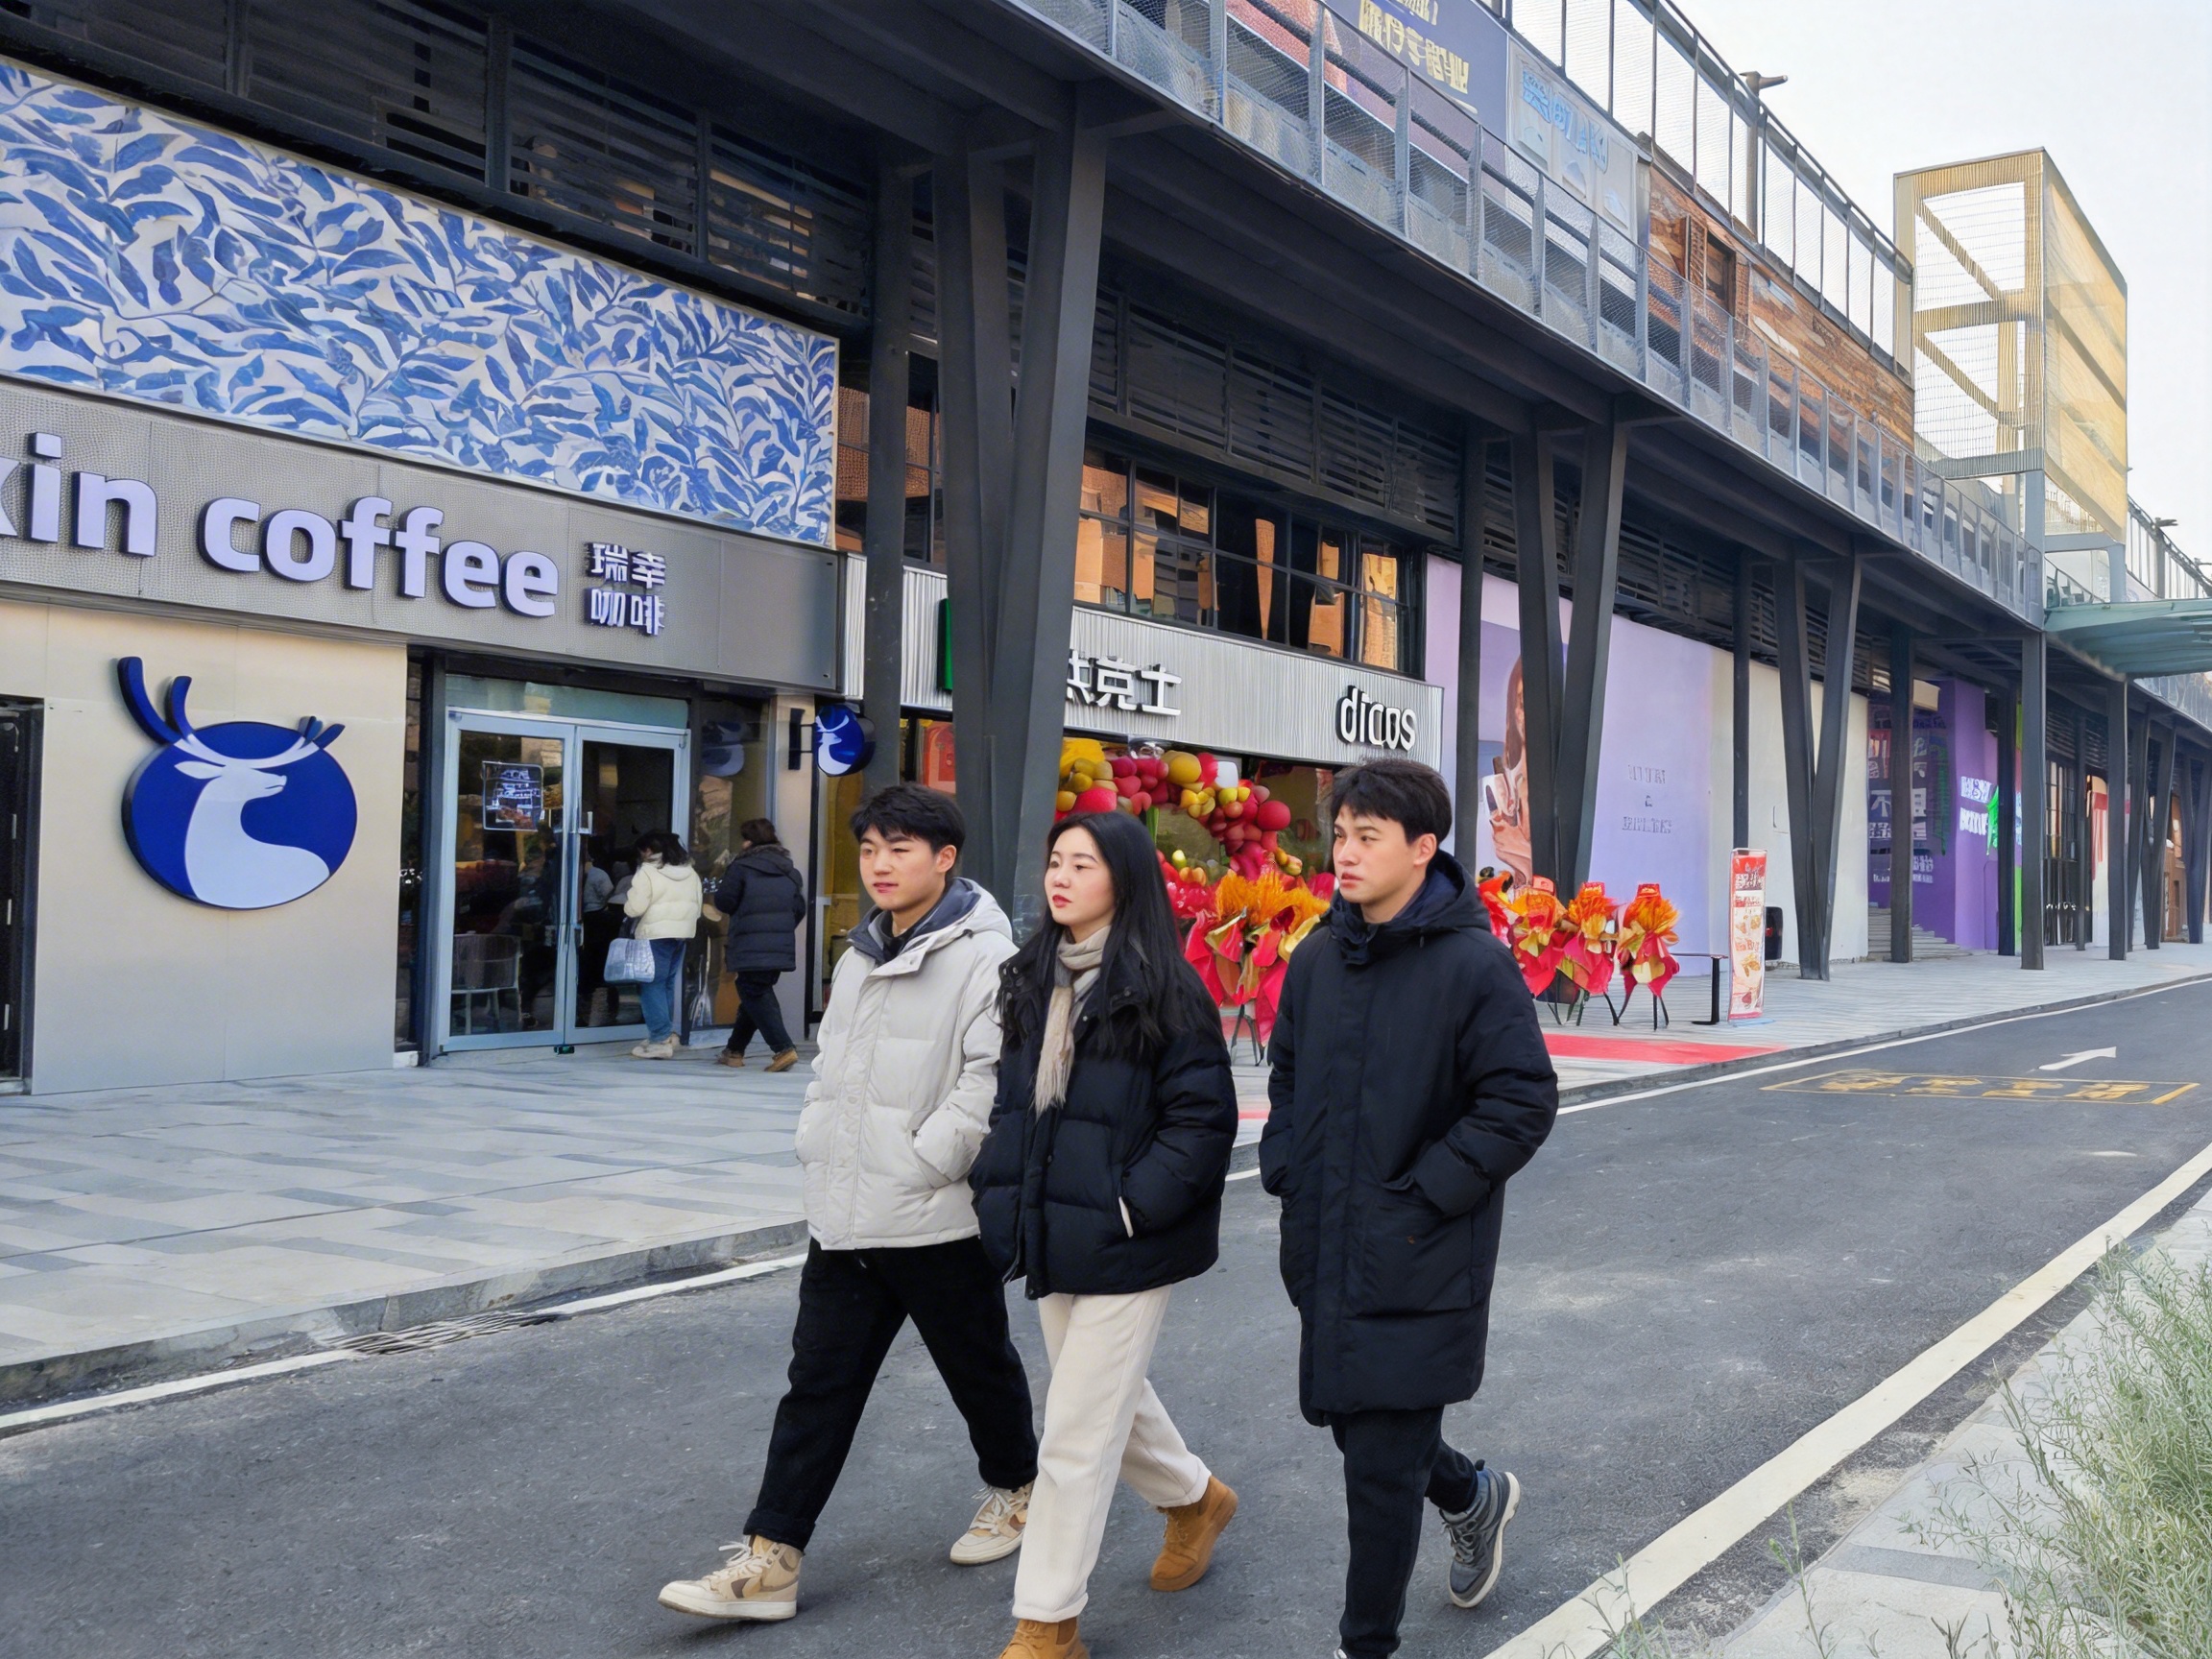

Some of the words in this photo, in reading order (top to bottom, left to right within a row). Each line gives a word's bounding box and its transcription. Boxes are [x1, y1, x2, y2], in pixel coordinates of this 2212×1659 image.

[199, 494, 559, 618] coffee
[588, 541, 667, 589] 瑞幸
[587, 588, 666, 636] 咖啡
[1335, 685, 1416, 752] dicos
